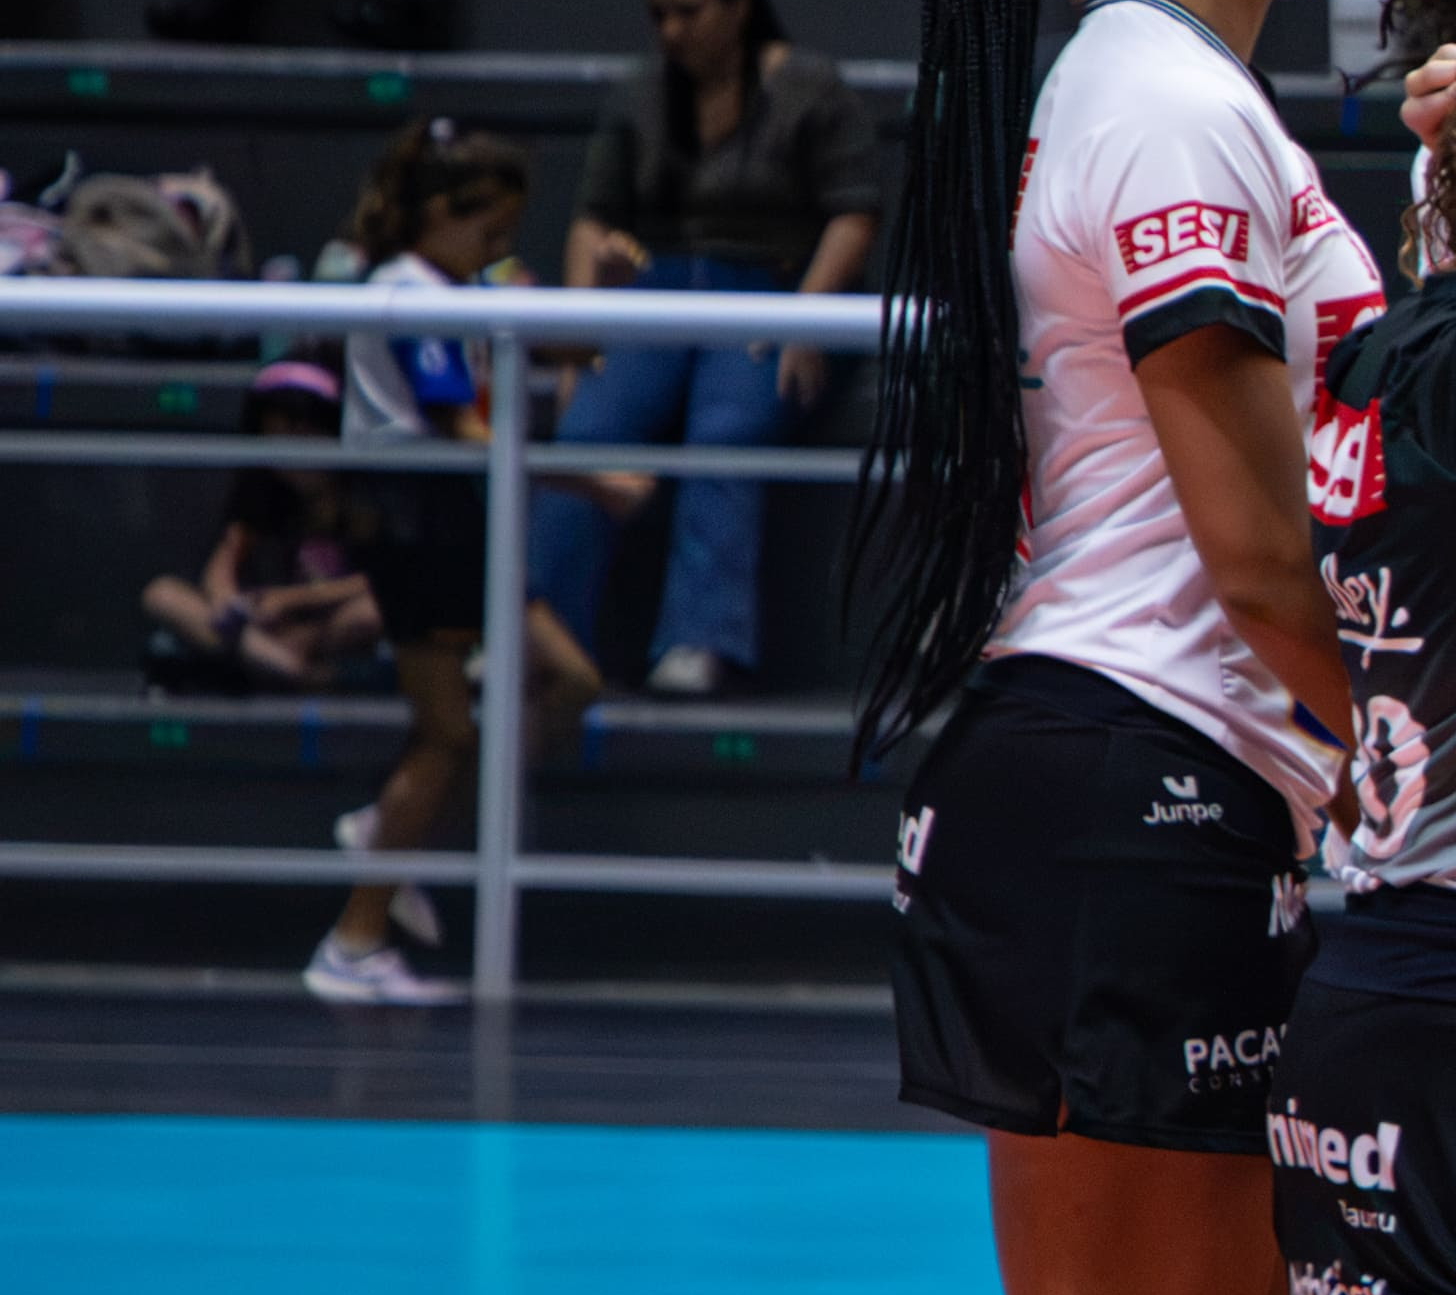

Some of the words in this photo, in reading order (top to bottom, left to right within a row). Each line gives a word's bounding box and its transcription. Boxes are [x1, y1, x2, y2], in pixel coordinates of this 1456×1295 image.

[1131, 205, 1241, 266] SESI
[1266, 1097, 1401, 1192] nimed
[1338, 1198, 1396, 1233] auru
